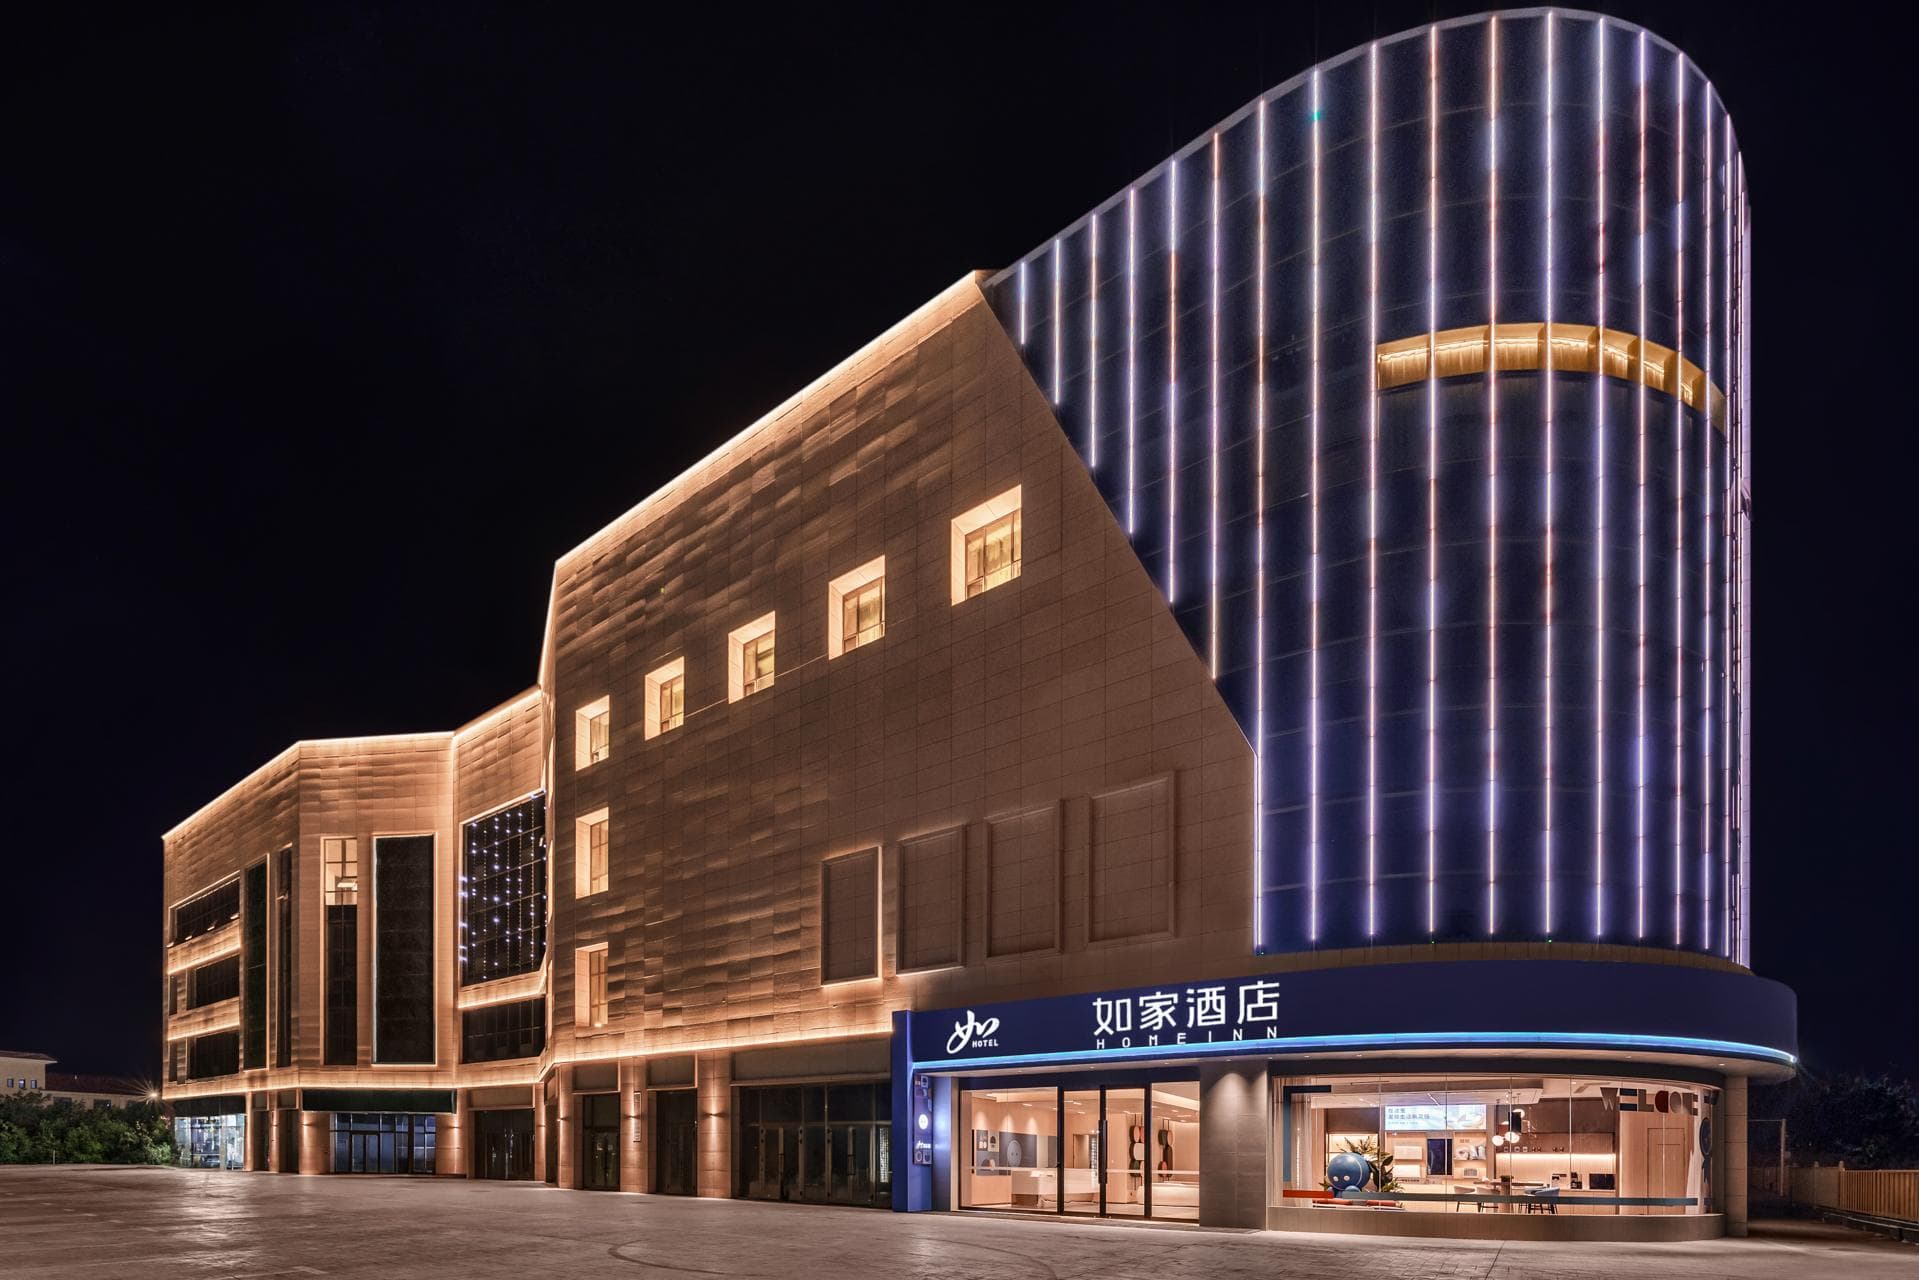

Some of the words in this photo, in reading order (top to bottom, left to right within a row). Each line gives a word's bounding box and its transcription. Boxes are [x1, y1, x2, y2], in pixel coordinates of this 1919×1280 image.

[1092, 980, 1280, 1036] 如家酒店
[971, 1039, 999, 1048] HOTEL
